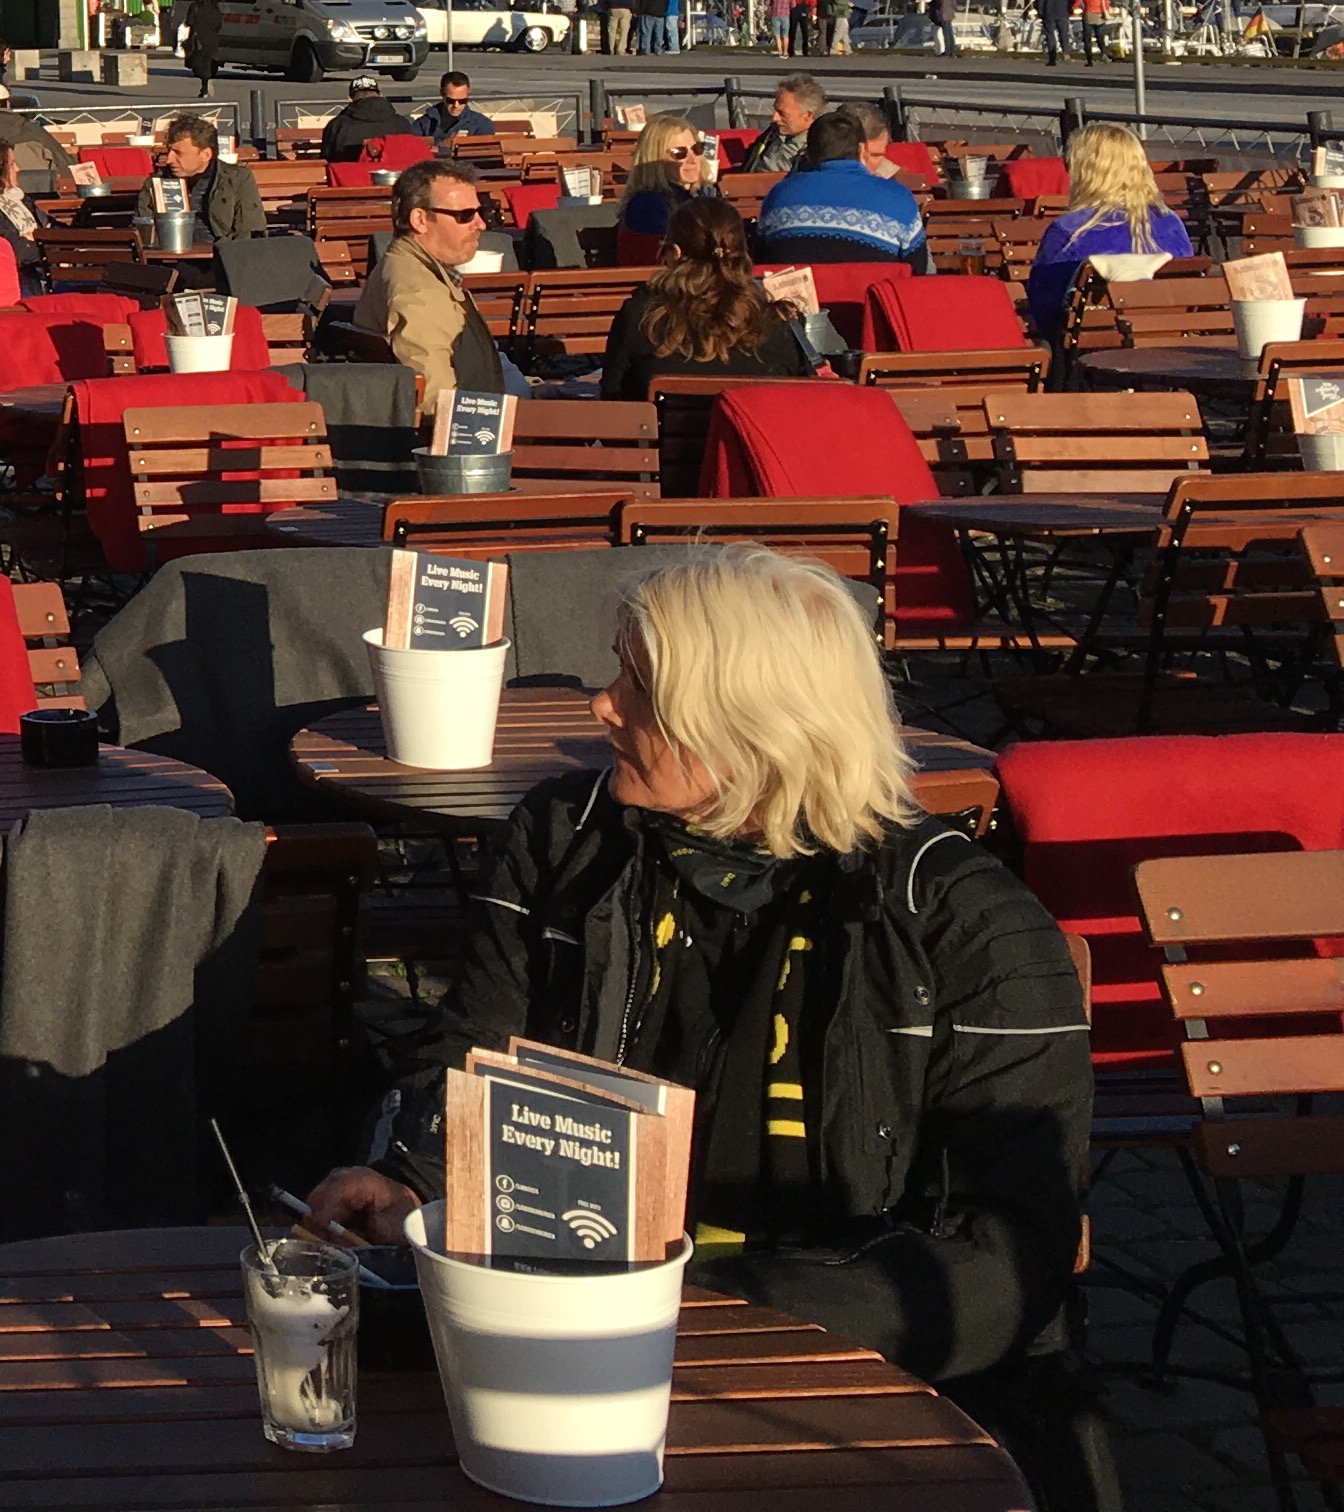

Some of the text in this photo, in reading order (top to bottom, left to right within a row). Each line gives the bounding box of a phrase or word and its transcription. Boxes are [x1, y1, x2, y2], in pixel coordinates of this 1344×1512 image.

[421, 575, 483, 594] Every Night!
[427, 563, 480, 581] Live Music
[511, 1103, 612, 1144] Live Music
[501, 1124, 621, 1170] Every Night!
